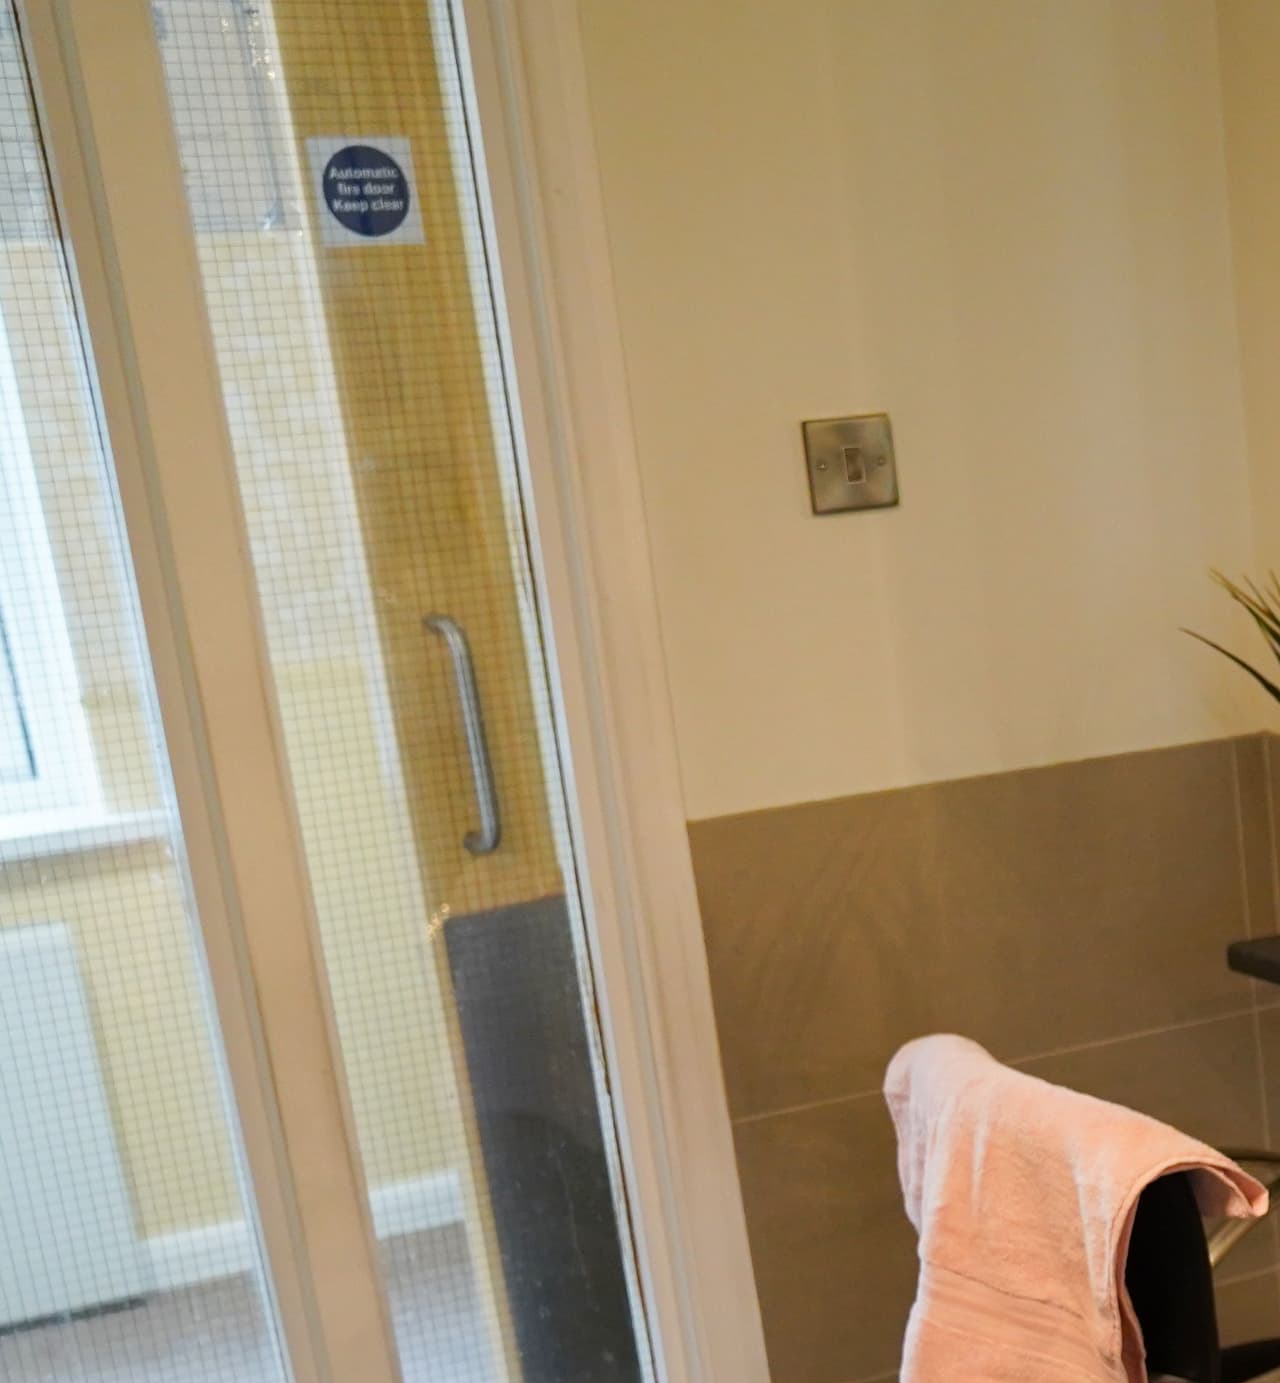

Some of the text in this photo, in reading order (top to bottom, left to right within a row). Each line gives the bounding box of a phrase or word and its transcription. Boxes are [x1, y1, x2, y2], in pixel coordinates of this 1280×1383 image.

[330, 167, 398, 180] Automatic
[363, 182, 395, 195] door
[333, 198, 404, 214] Keep clear
